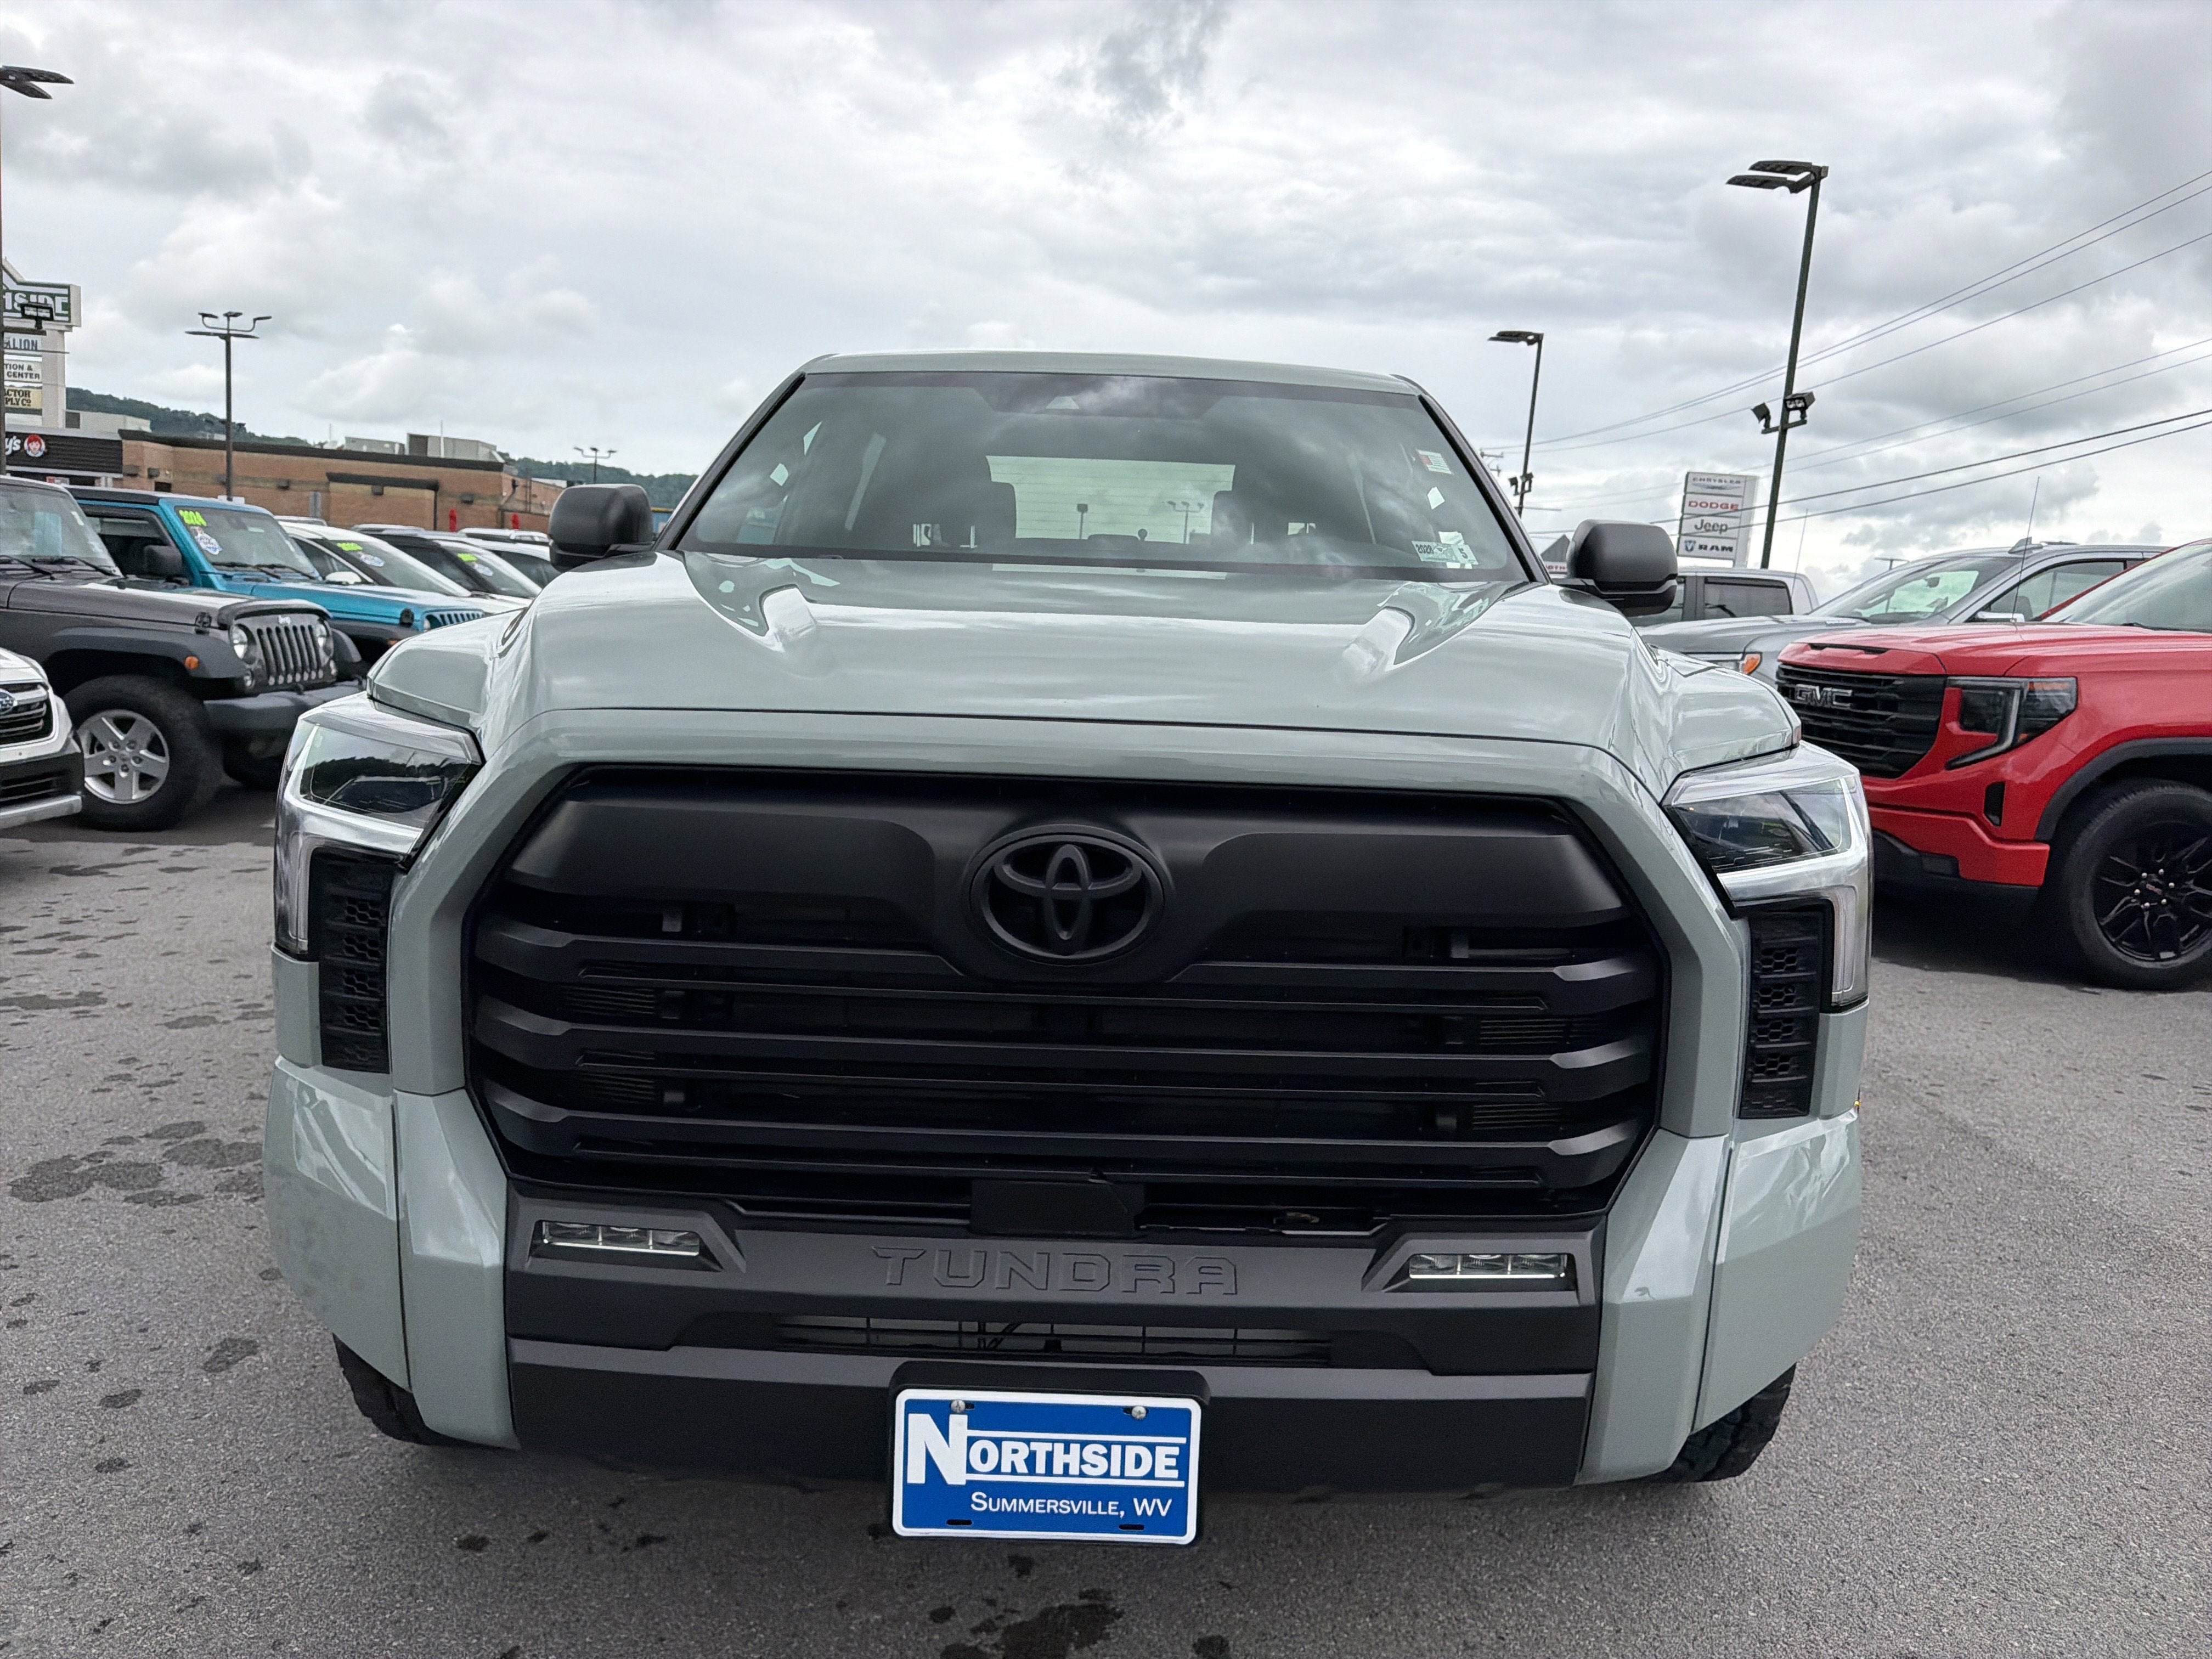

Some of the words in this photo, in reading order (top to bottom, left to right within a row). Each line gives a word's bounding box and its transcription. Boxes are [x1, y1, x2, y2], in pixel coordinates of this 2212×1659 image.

[7, 371, 40, 380] CENTER
[1689, 500, 1739, 511] DODGE
[1694, 519, 1728, 535] Jeep
[1699, 544, 1734, 552] RAM
[1795, 684, 1853, 708] GMC
[872, 1246, 1238, 1296] TUNDRA
[906, 1413, 1180, 1486] NORTHSIDE
[1133, 1498, 1172, 1517] WV
